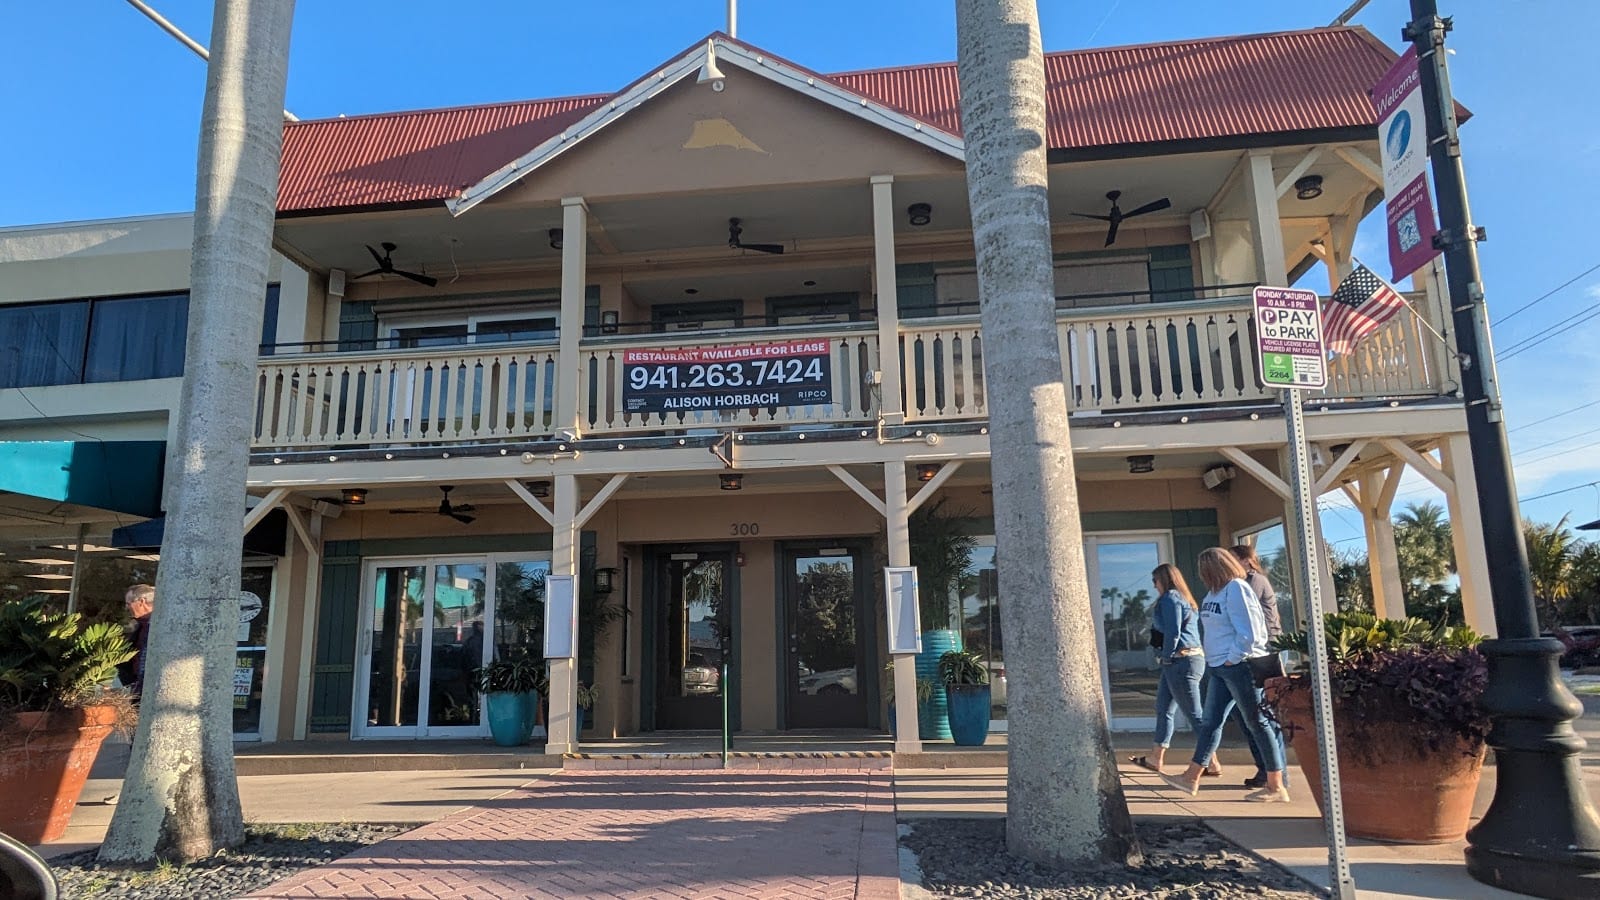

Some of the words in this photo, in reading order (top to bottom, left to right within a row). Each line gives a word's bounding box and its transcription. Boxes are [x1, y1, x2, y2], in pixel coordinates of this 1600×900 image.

[1377, 70, 1417, 116] Welcome
[1257, 290, 1281, 298] MONDAY
[1284, 292, 1314, 301] SATURDAY
[1278, 310, 1314, 325] PAY
[1265, 326, 1277, 337] to
[1280, 326, 1316, 340] PARK
[628, 351, 699, 361] RESTAURANT
[702, 347, 763, 359] AVAILABLE
[765, 345, 788, 355] FOR
[790, 342, 825, 353] LEASE
[630, 357, 824, 390] 941.263.7424
[663, 396, 713, 409] ALISON
[715, 392, 779, 407] HORBACH
[798, 390, 827, 399] RIPCO
[730, 522, 759, 536] 300
